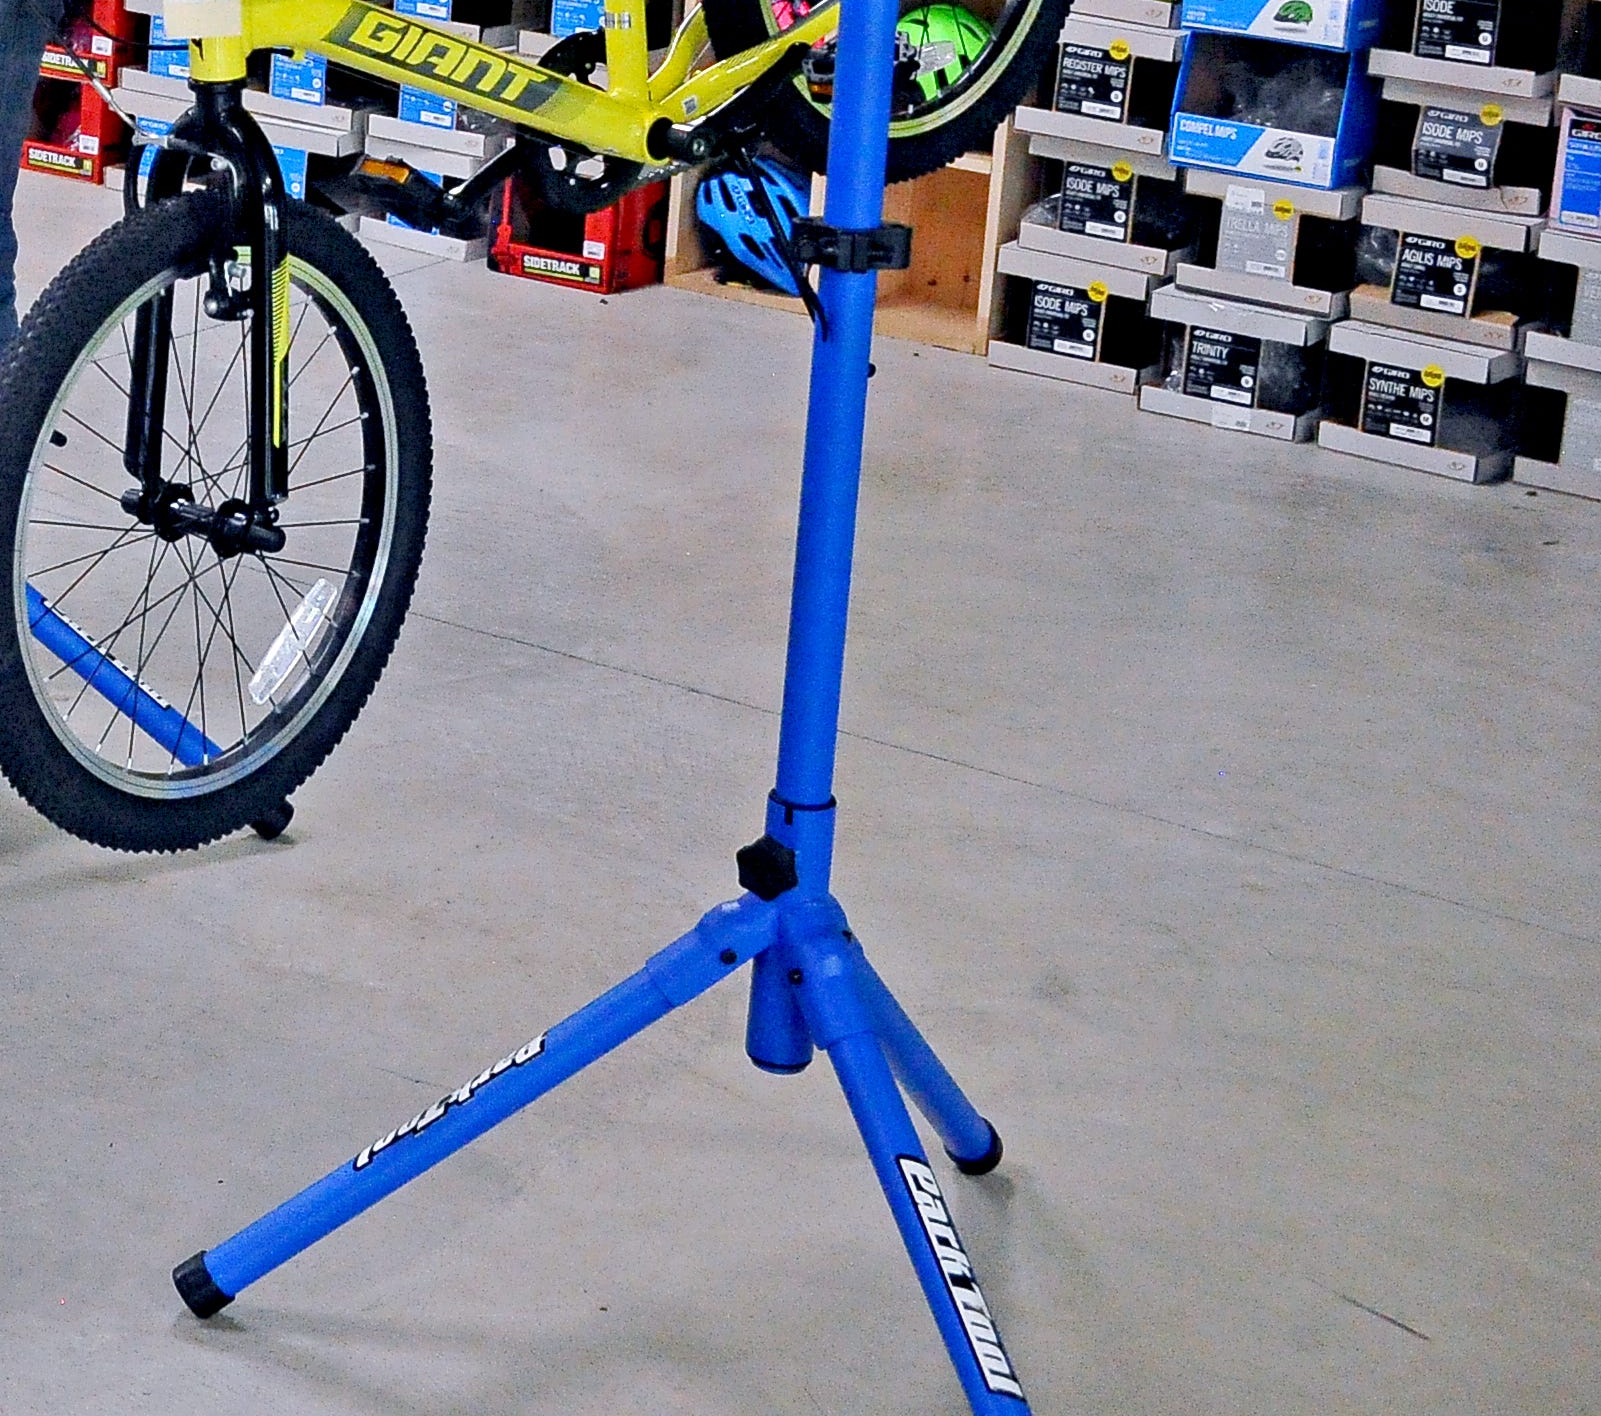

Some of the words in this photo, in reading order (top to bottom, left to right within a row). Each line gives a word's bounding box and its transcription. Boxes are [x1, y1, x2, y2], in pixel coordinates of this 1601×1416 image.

[42, 51, 89, 69] SIDETRAK
[349, 9, 549, 103] GIANT
[1077, 47, 1103, 59] GIRO
[1062, 57, 1103, 74] REGISTER
[1104, 64, 1127, 78] MIPS
[1440, 112, 1469, 123] GIRO
[1179, 119, 1214, 136] COMPEL
[1215, 125, 1238, 141] MIPS
[1422, 121, 1454, 139] ISODE
[1456, 127, 1483, 145] MIPS
[28, 148, 77, 168] SIDETRACK
[1080, 167, 1106, 178] GIRO
[1066, 176, 1094, 193] ISODE
[1095, 182, 1120, 198] MIPS
[1418, 238, 1446, 250] GIRO
[523, 255, 581, 276] SIDETRACK
[1402, 248, 1435, 266] AGILIS
[1436, 254, 1463, 271] MIPS
[1048, 285, 1075, 296] GIRO
[1034, 295, 1062, 311] ISODE
[1064, 300, 1089, 317] MIPS
[1205, 332, 1232, 343] GIRO
[1192, 340, 1230, 360] TRINITY
[1384, 368, 1410, 380] GIRO
[1368, 377, 1409, 397] SYNTHE
[1409, 385, 1435, 403] MIPS
